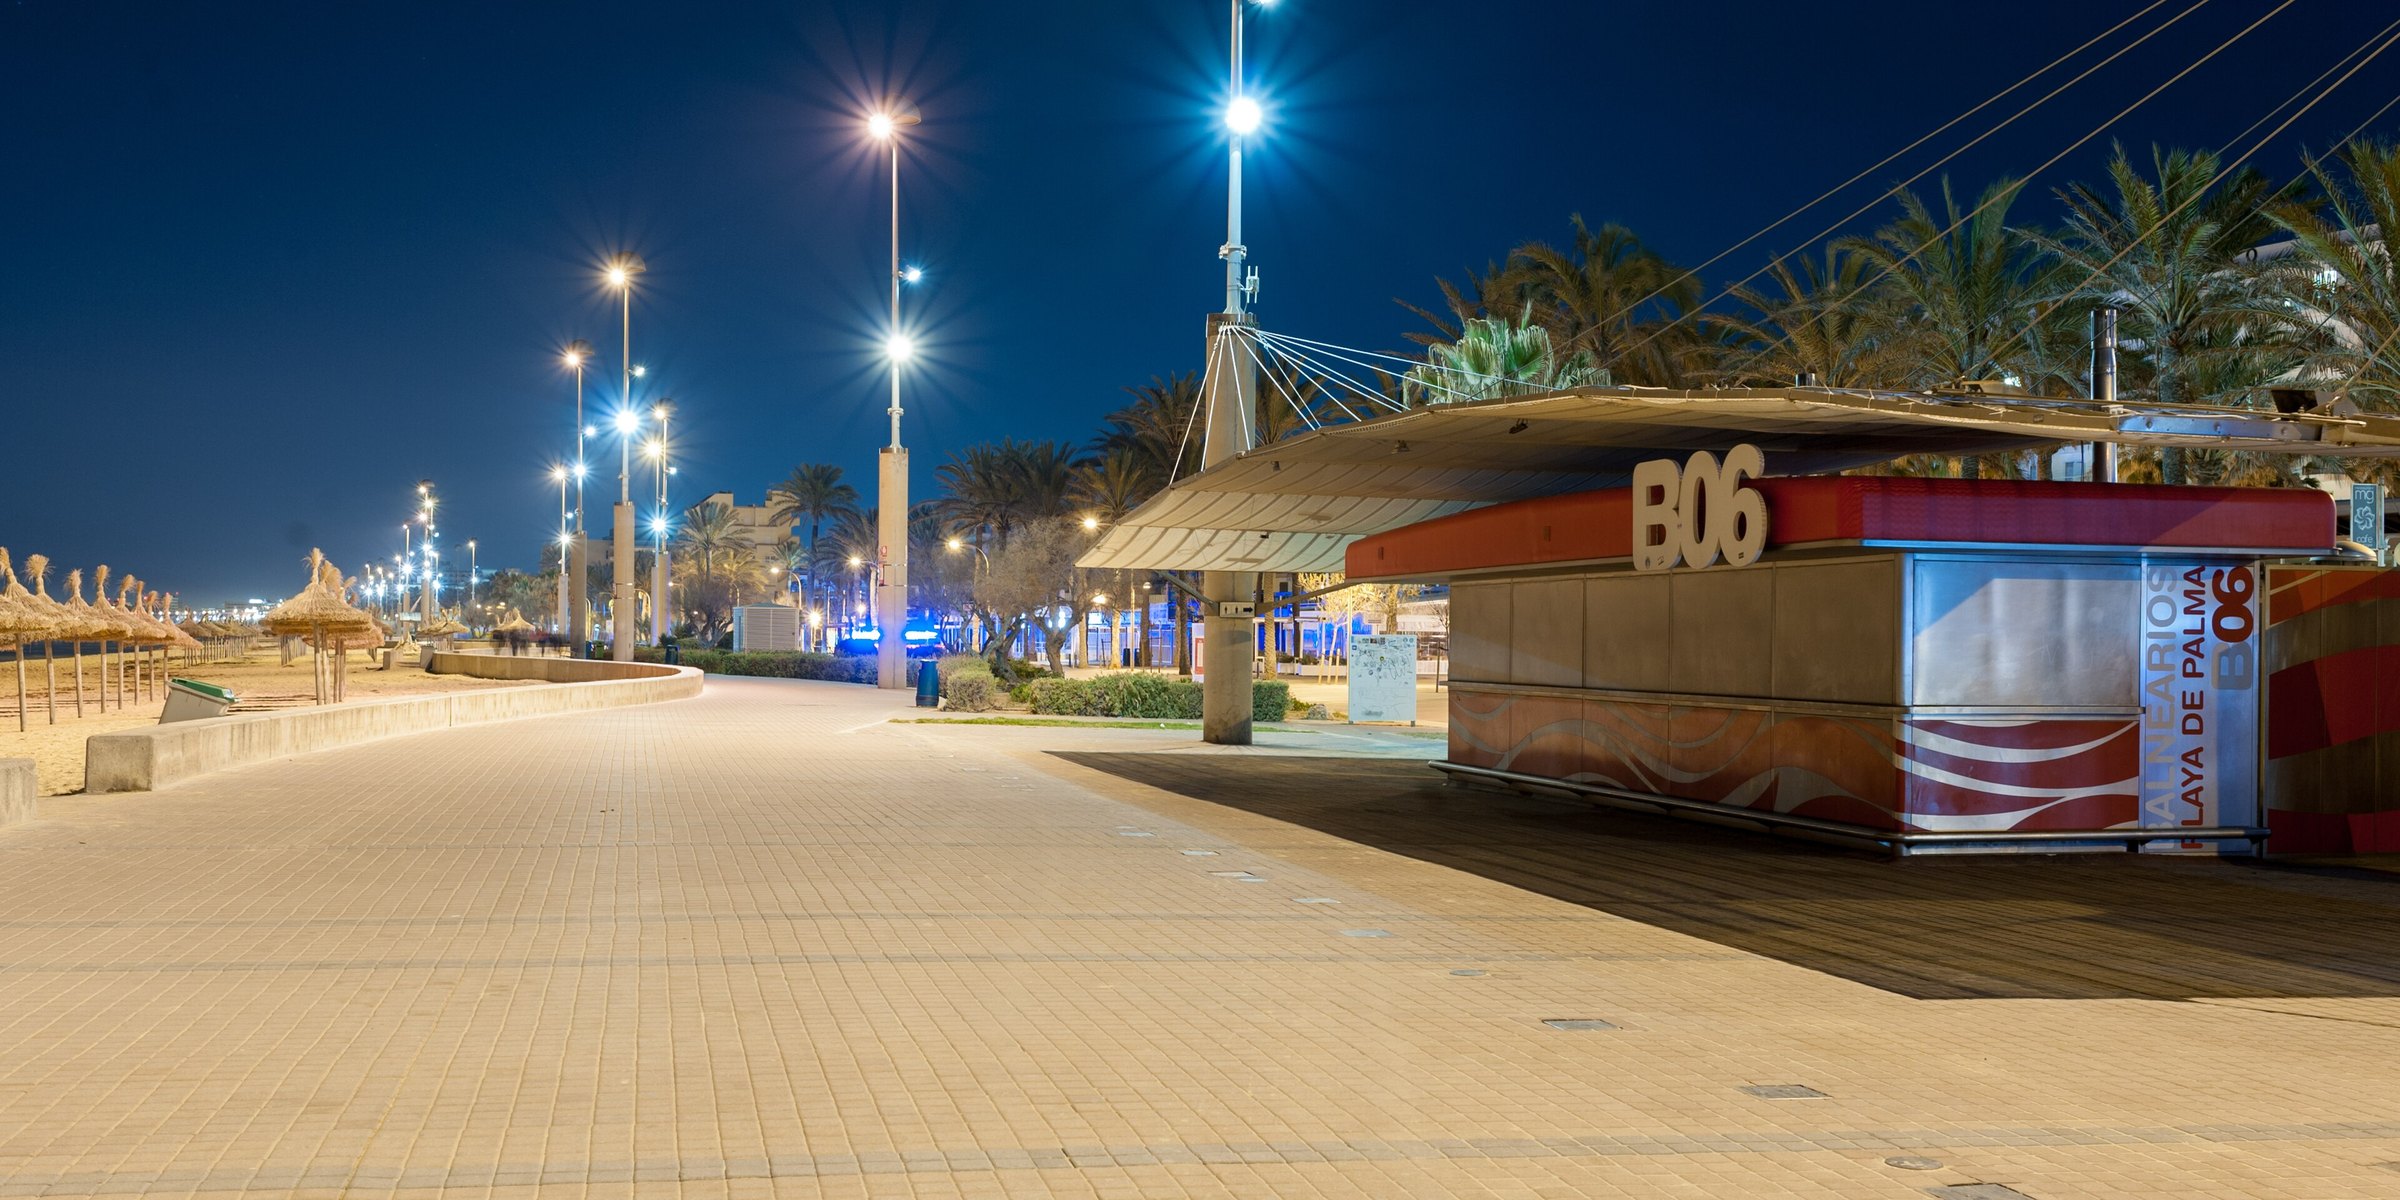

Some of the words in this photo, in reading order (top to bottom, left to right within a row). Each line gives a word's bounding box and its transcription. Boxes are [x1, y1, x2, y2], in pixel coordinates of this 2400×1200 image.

[1633, 443, 1767, 571] B06
[2355, 490, 2374, 504] mg
[2182, 566, 2205, 678] PALMA
[2212, 566, 2254, 689] B06
[2146, 567, 2177, 849] BALNEARIOS
[2181, 690, 2204, 735] DE
